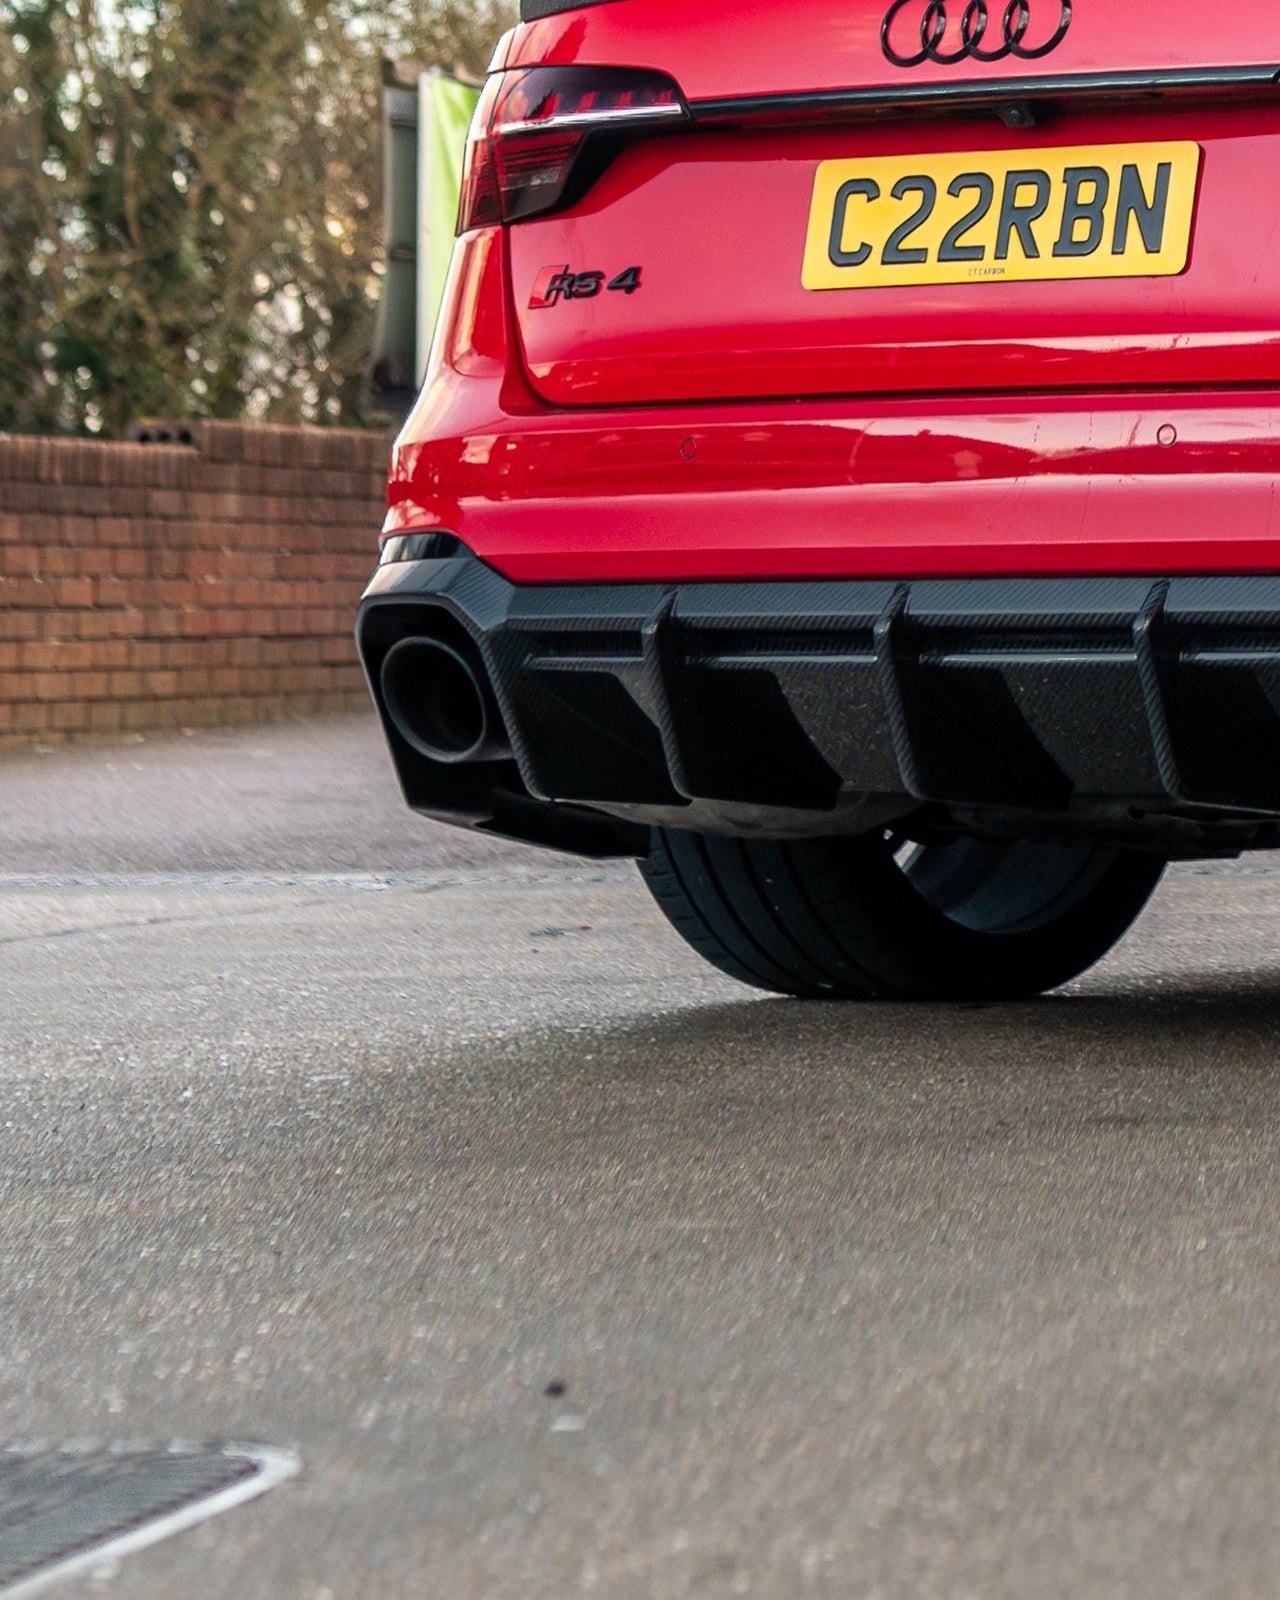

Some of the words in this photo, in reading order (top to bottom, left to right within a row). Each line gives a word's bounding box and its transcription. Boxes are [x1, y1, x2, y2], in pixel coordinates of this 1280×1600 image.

[828, 162, 1172, 267] C22RBN
[540, 266, 605, 303] RS
[607, 266, 642, 294] 4
